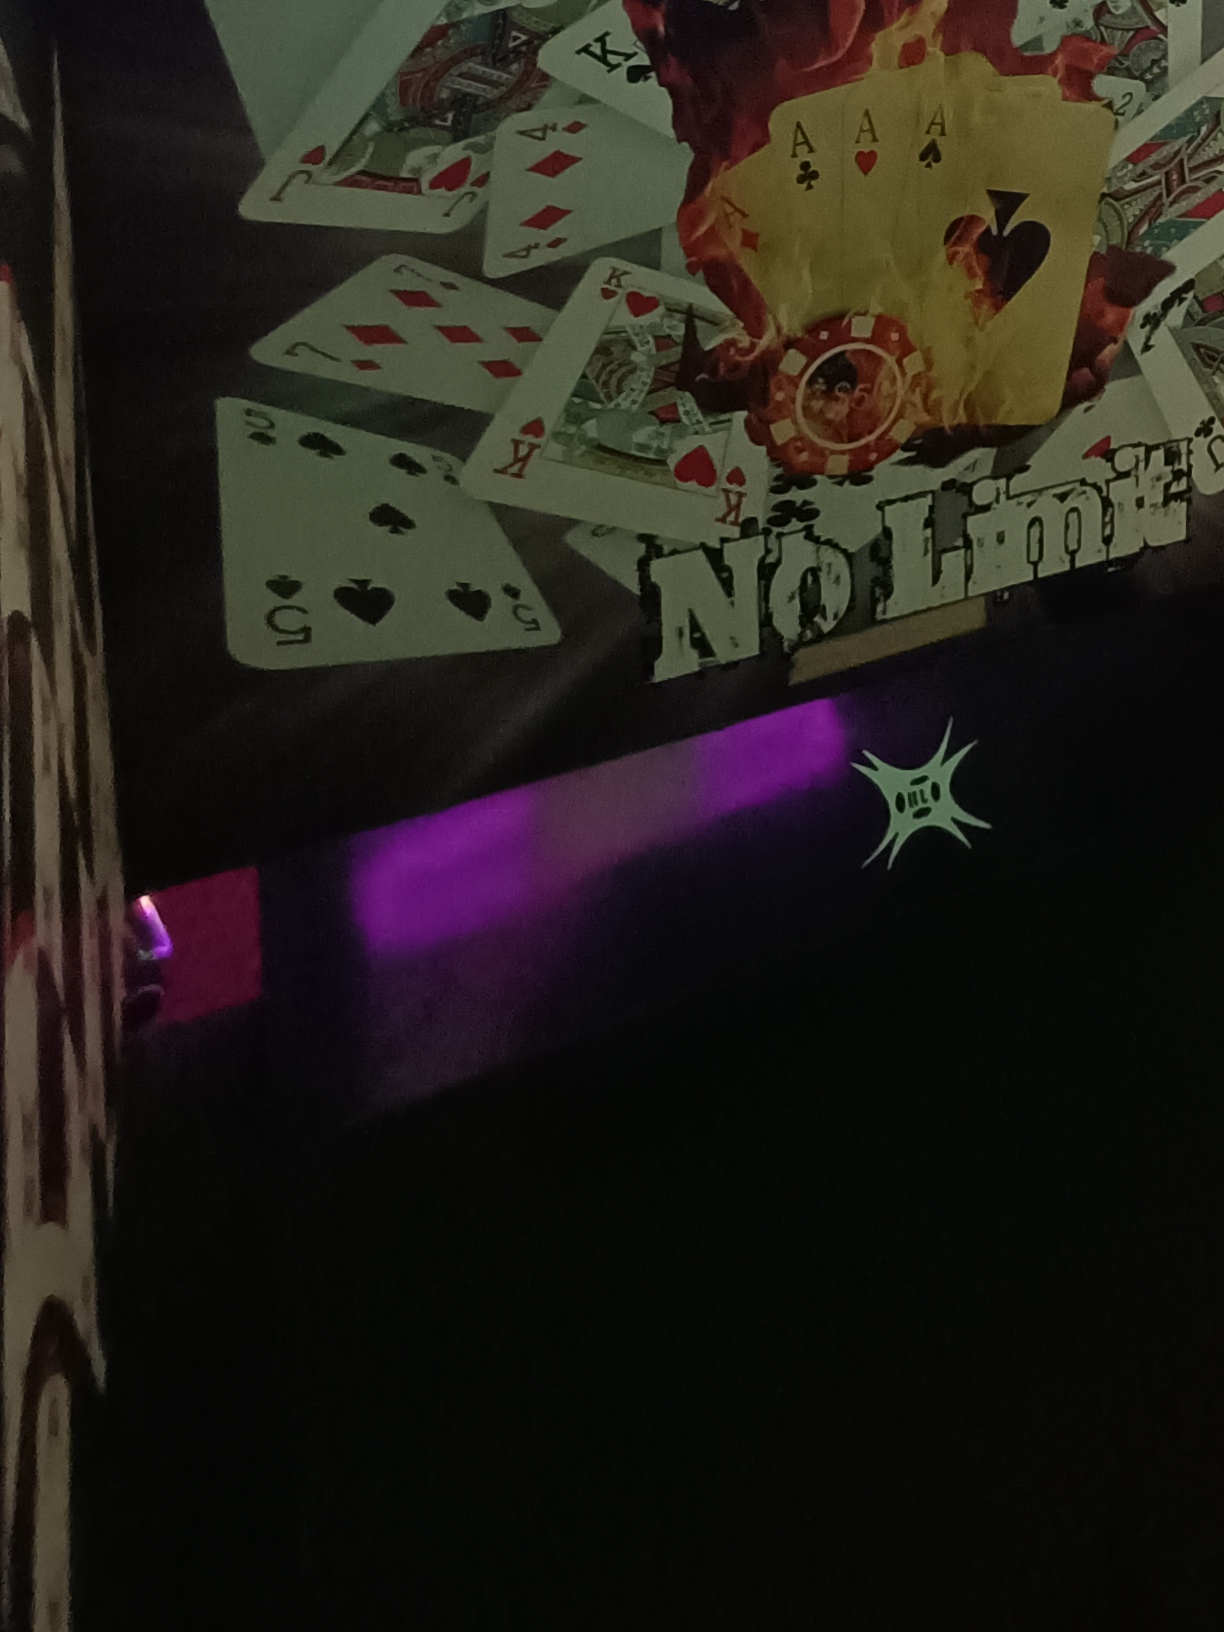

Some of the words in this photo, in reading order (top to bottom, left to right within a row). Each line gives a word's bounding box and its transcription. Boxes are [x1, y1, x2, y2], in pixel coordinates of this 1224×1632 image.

[574, 30, 639, 74] K
[790, 120, 816, 159] A
[854, 107, 880, 145] A
[924, 103, 948, 138] A
[602, 266, 633, 289] K
